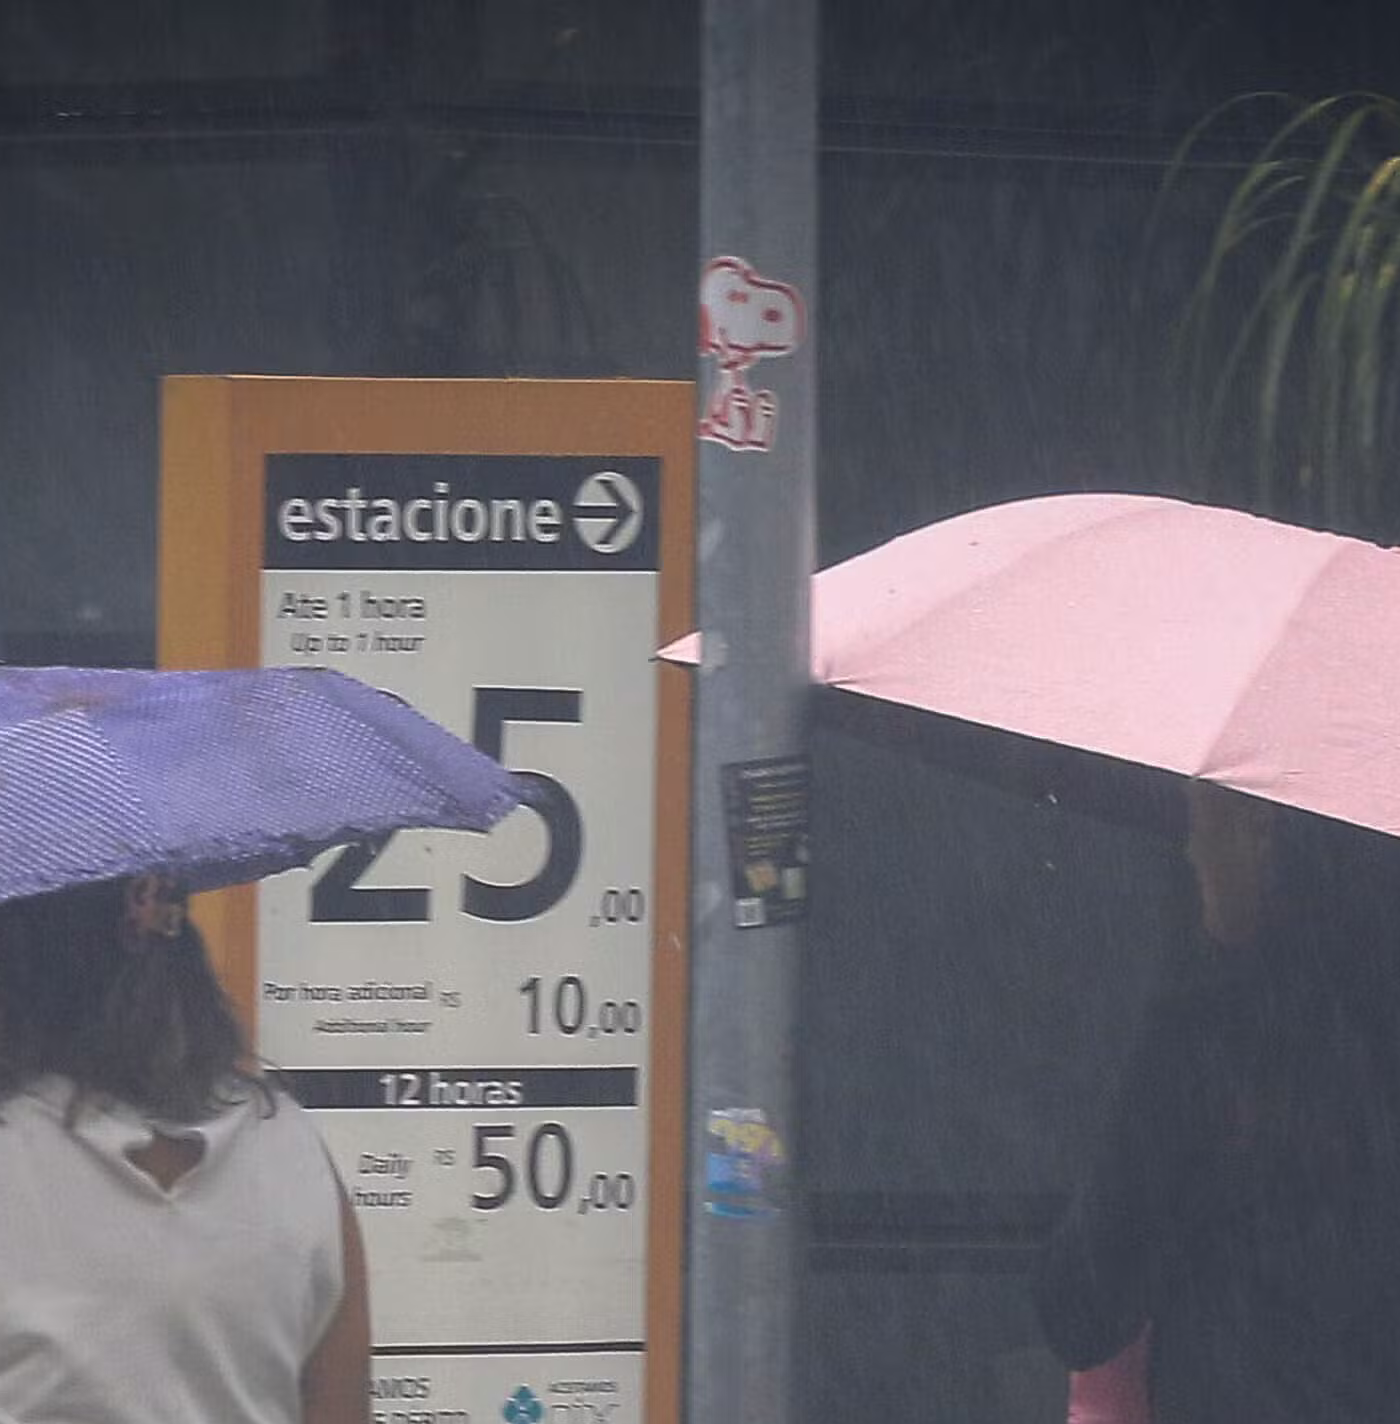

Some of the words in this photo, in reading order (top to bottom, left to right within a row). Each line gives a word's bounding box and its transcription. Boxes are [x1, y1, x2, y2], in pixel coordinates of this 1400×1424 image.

[277, 481, 562, 543] estacione
[337, 590, 350, 618] 1
[359, 589, 425, 619] hora
[290, 632, 323, 656] Up
[328, 632, 350, 653] to
[371, 631, 425, 653] hour
[379, 1073, 422, 1105] 12
[428, 1072, 522, 1105] horas
[357, 1152, 413, 1180] Daily
[354, 1187, 413, 1208] hours
